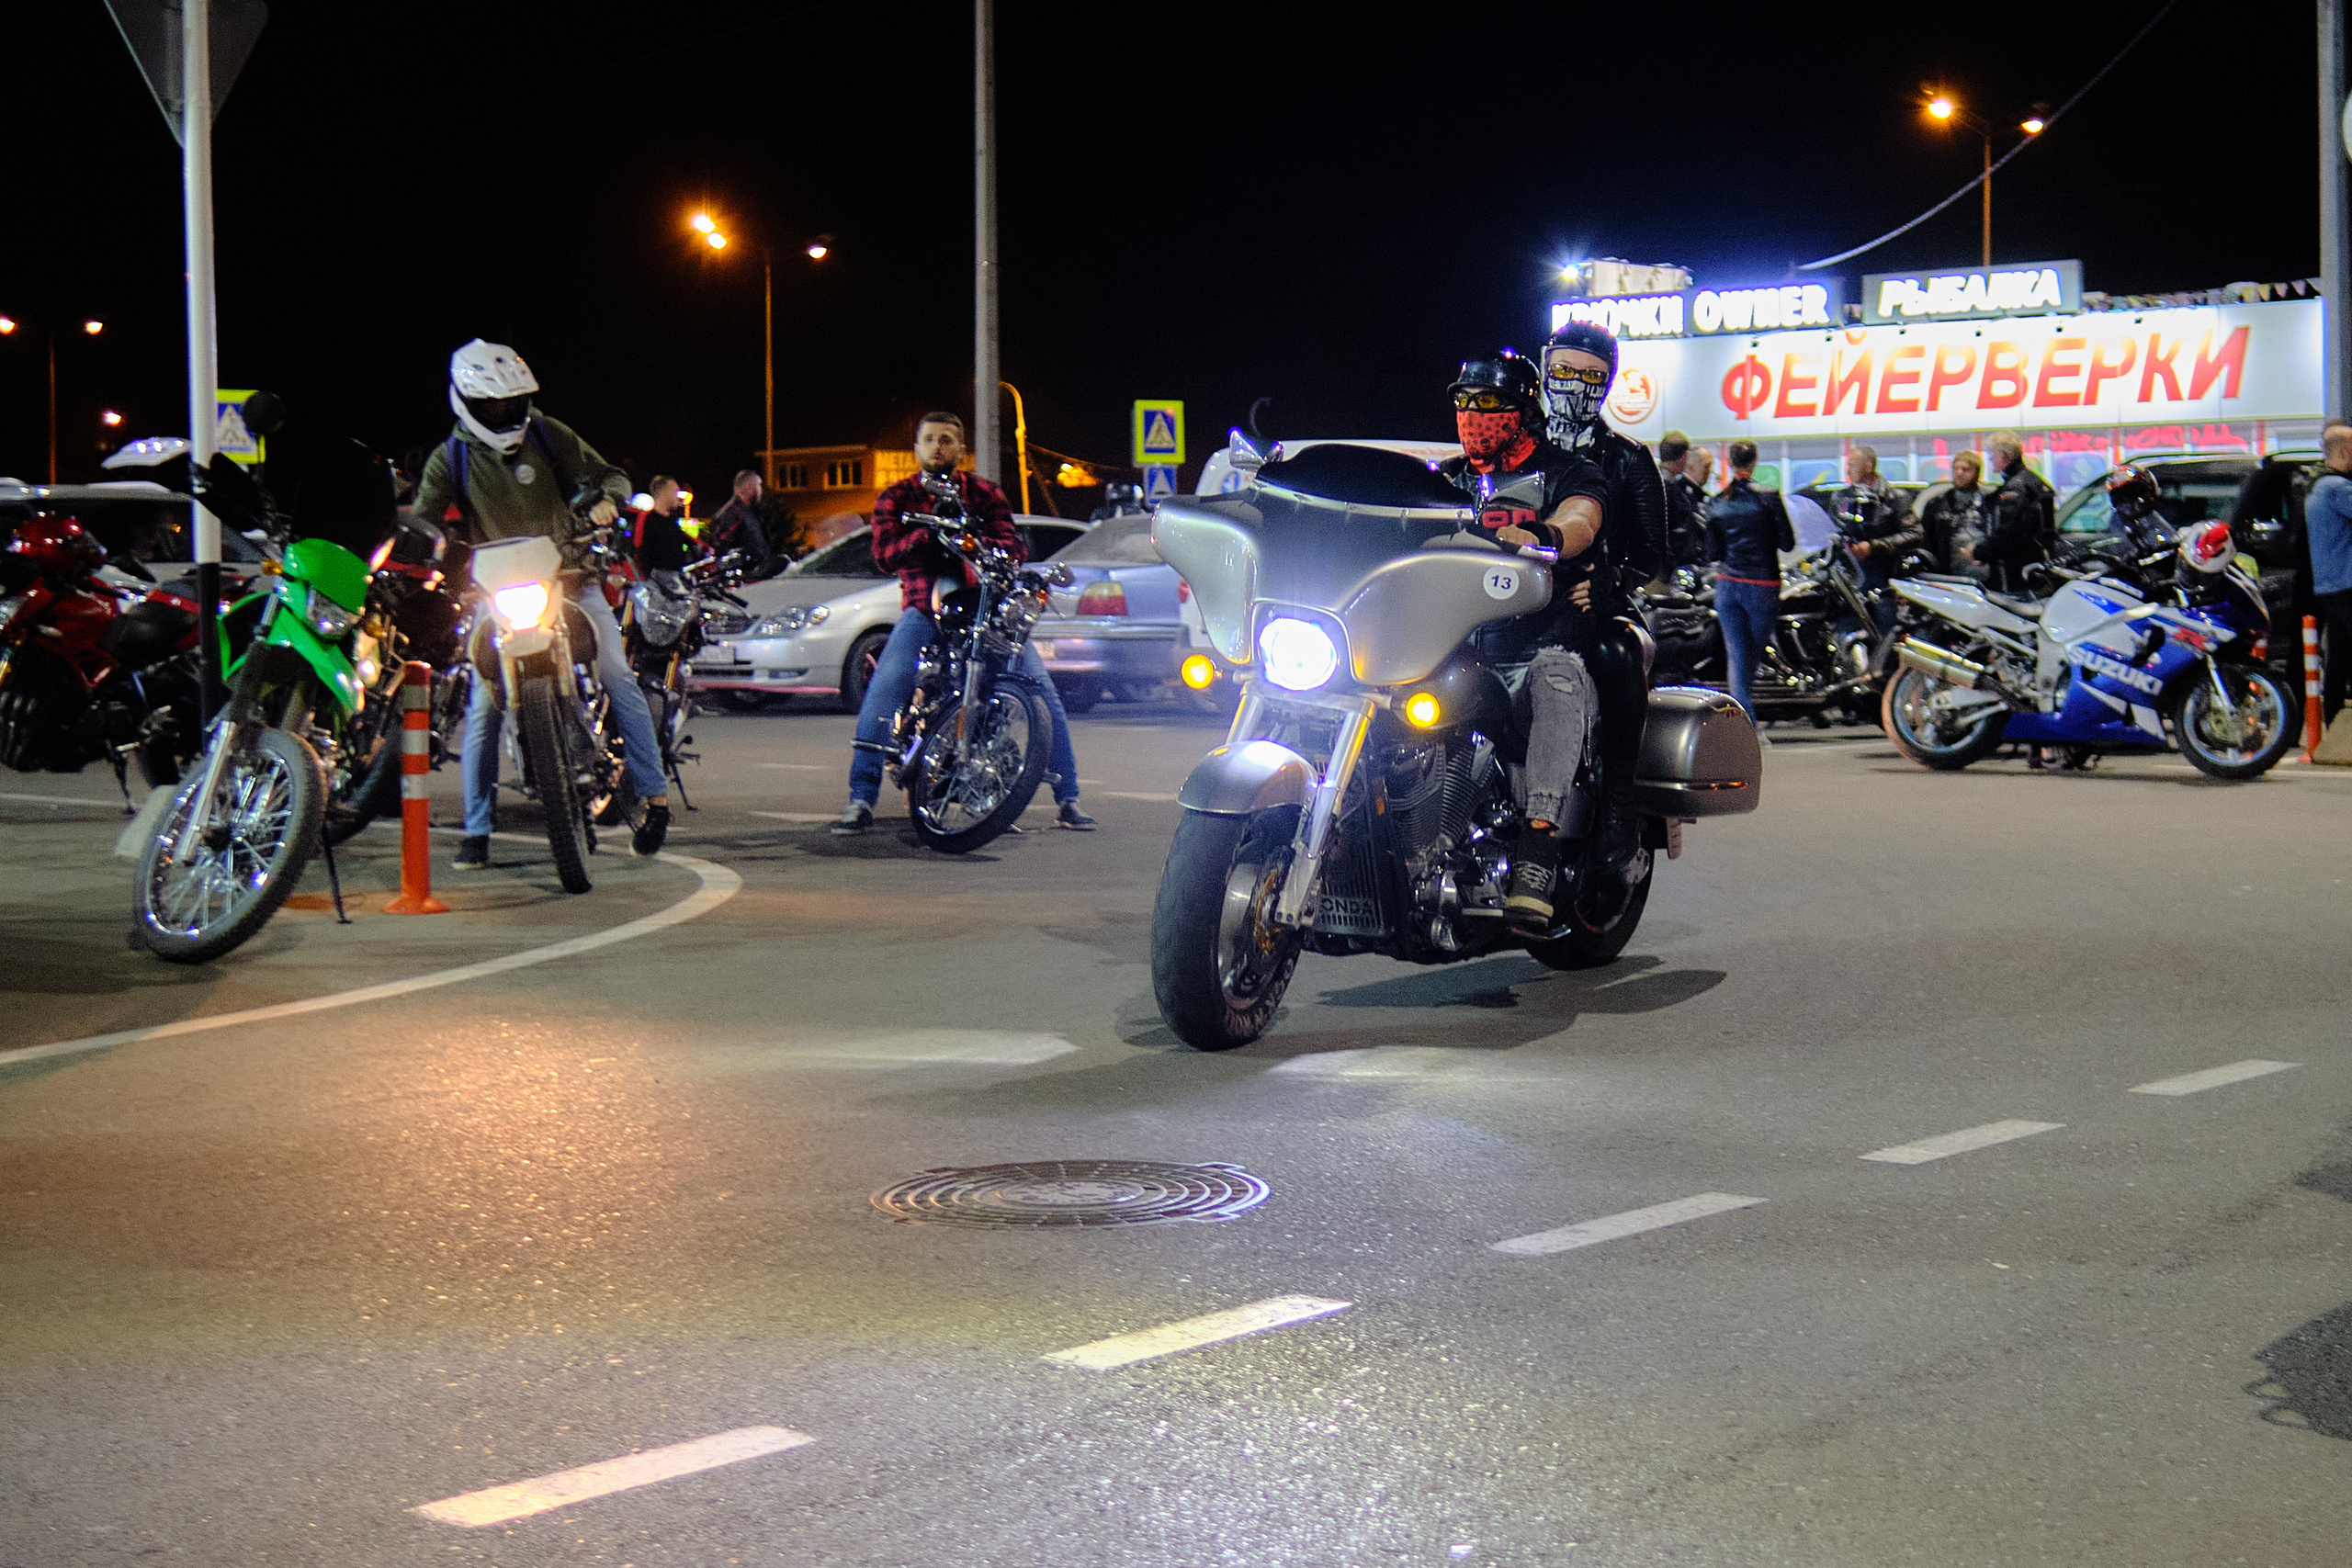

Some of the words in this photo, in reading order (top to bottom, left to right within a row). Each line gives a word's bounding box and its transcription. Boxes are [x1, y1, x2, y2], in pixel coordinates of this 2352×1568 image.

[1693, 284, 1831, 333] OWNER
[1878, 268, 2062, 317] РЫБАЛКА
[1720, 325, 2251, 421] ФЕЙЕРВЕРКИ
[1491, 575, 1511, 590] 13
[2067, 647, 2164, 696] SUZUKI
[1320, 897, 1374, 916] ONDA
